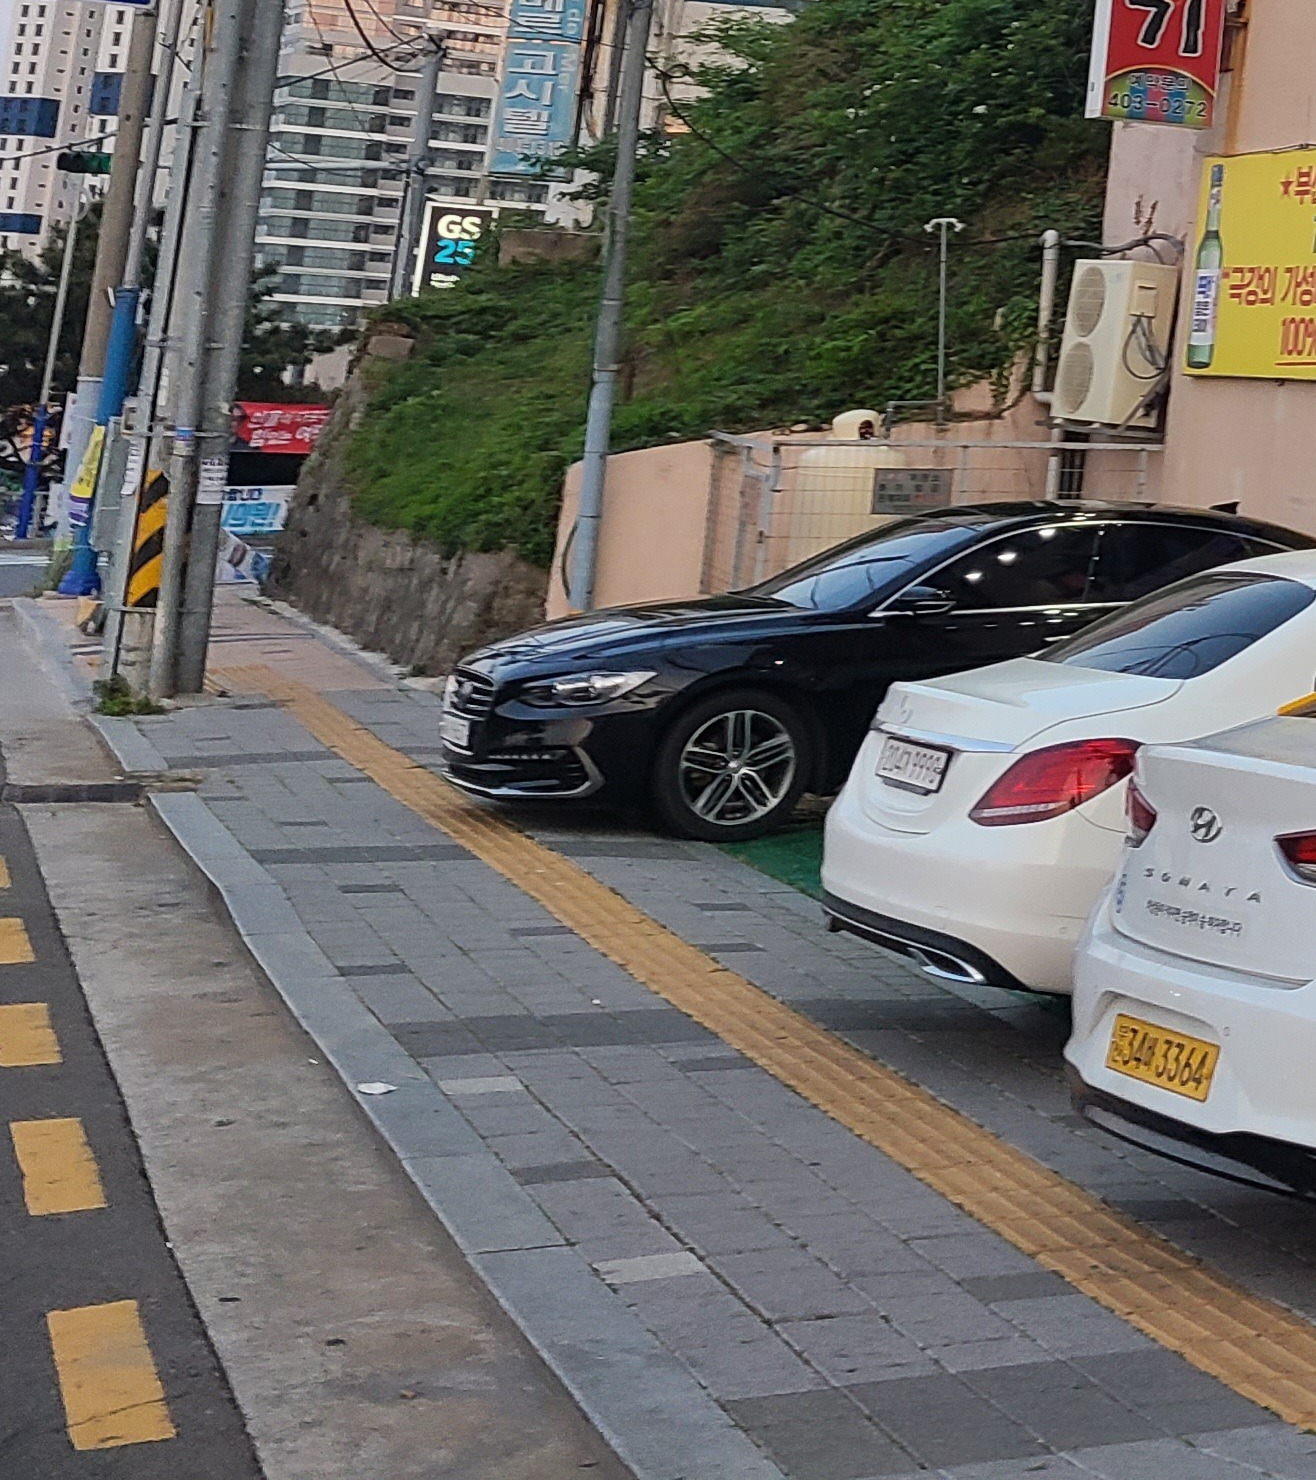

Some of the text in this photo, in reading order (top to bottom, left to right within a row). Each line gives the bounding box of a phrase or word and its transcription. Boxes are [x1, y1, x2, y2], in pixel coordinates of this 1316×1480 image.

[504, 49, 557, 135] 고시텔
[1107, 92, 1208, 118] 403-0272
[437, 214, 482, 240] GS
[434, 239, 475, 265] 25
